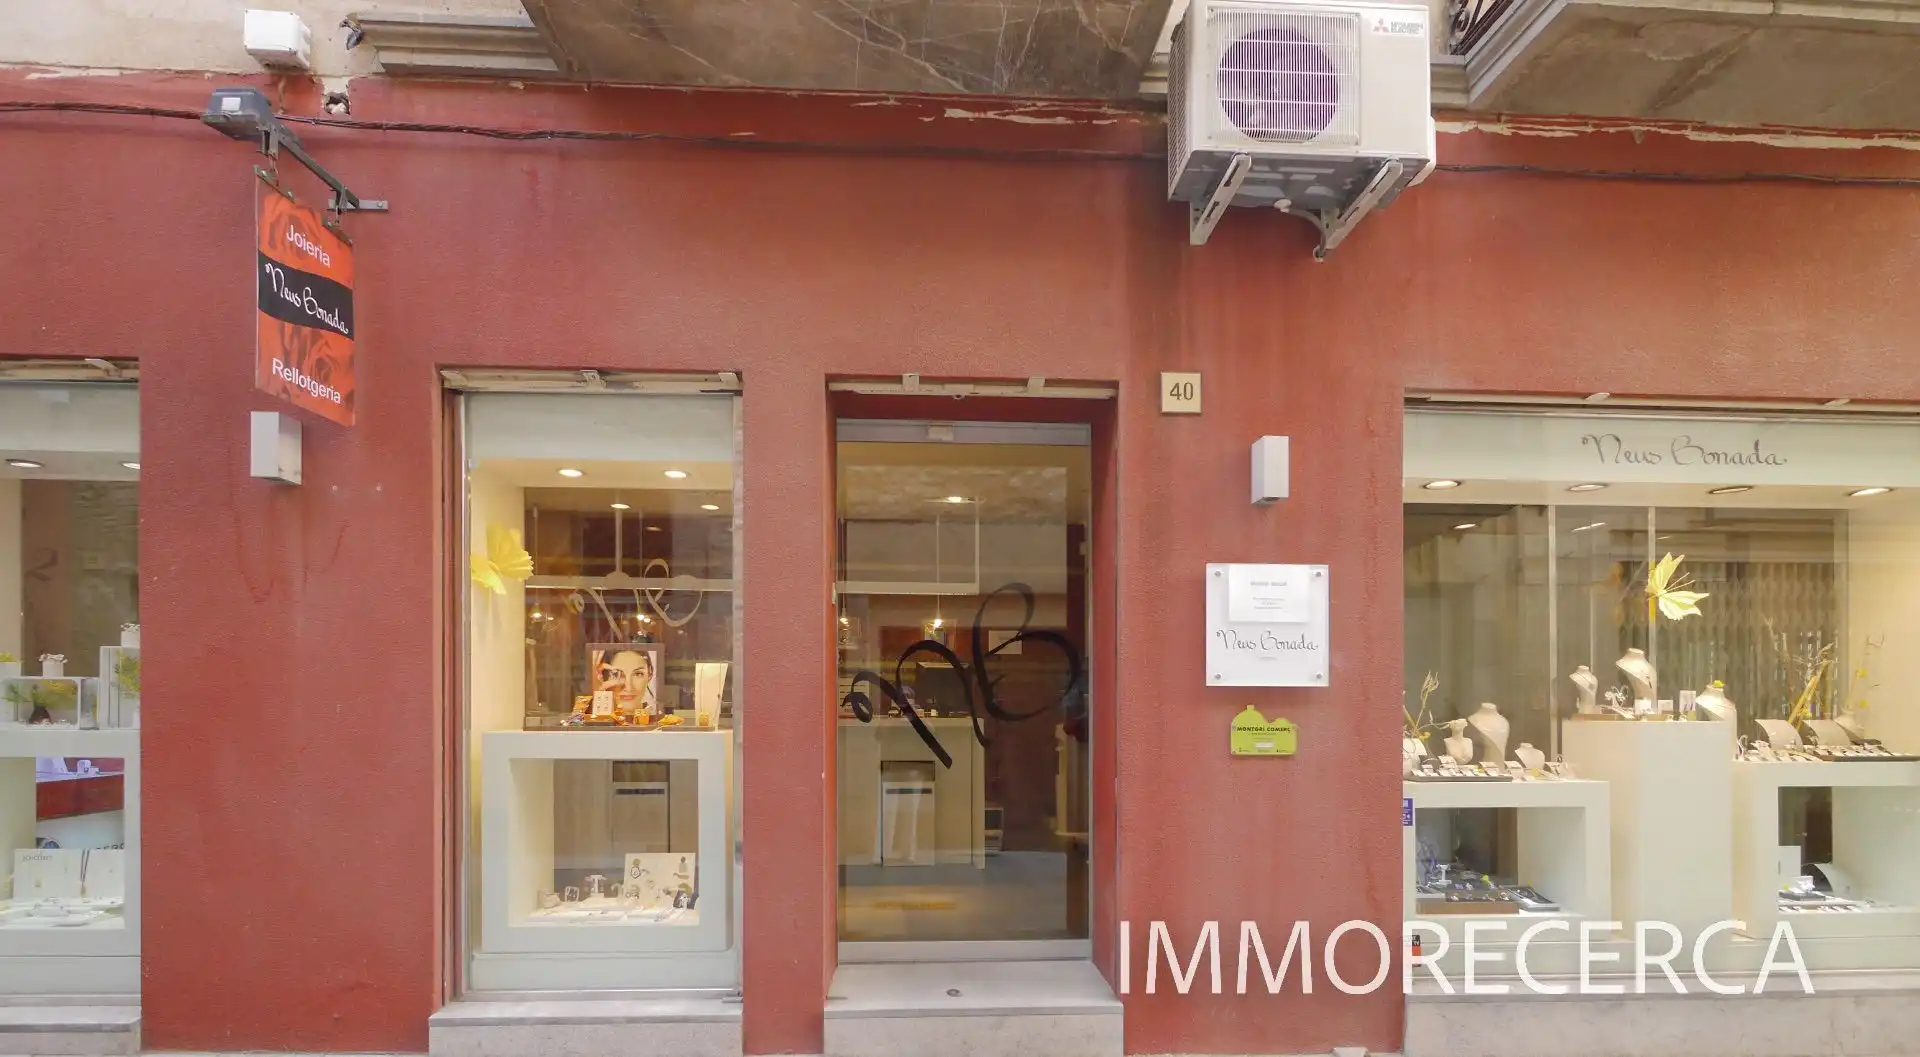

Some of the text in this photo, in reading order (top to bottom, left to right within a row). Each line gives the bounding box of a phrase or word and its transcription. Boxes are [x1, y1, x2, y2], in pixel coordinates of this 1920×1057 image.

[286, 224, 331, 268] Joieria
[265, 262, 349, 335] Neus Bonada
[272, 357, 342, 405] Rellotgeria
[1169, 382, 1194, 401] 40
[1581, 433, 1788, 466] Neus Bonada
[1216, 629, 1320, 651] Neus Bonada
